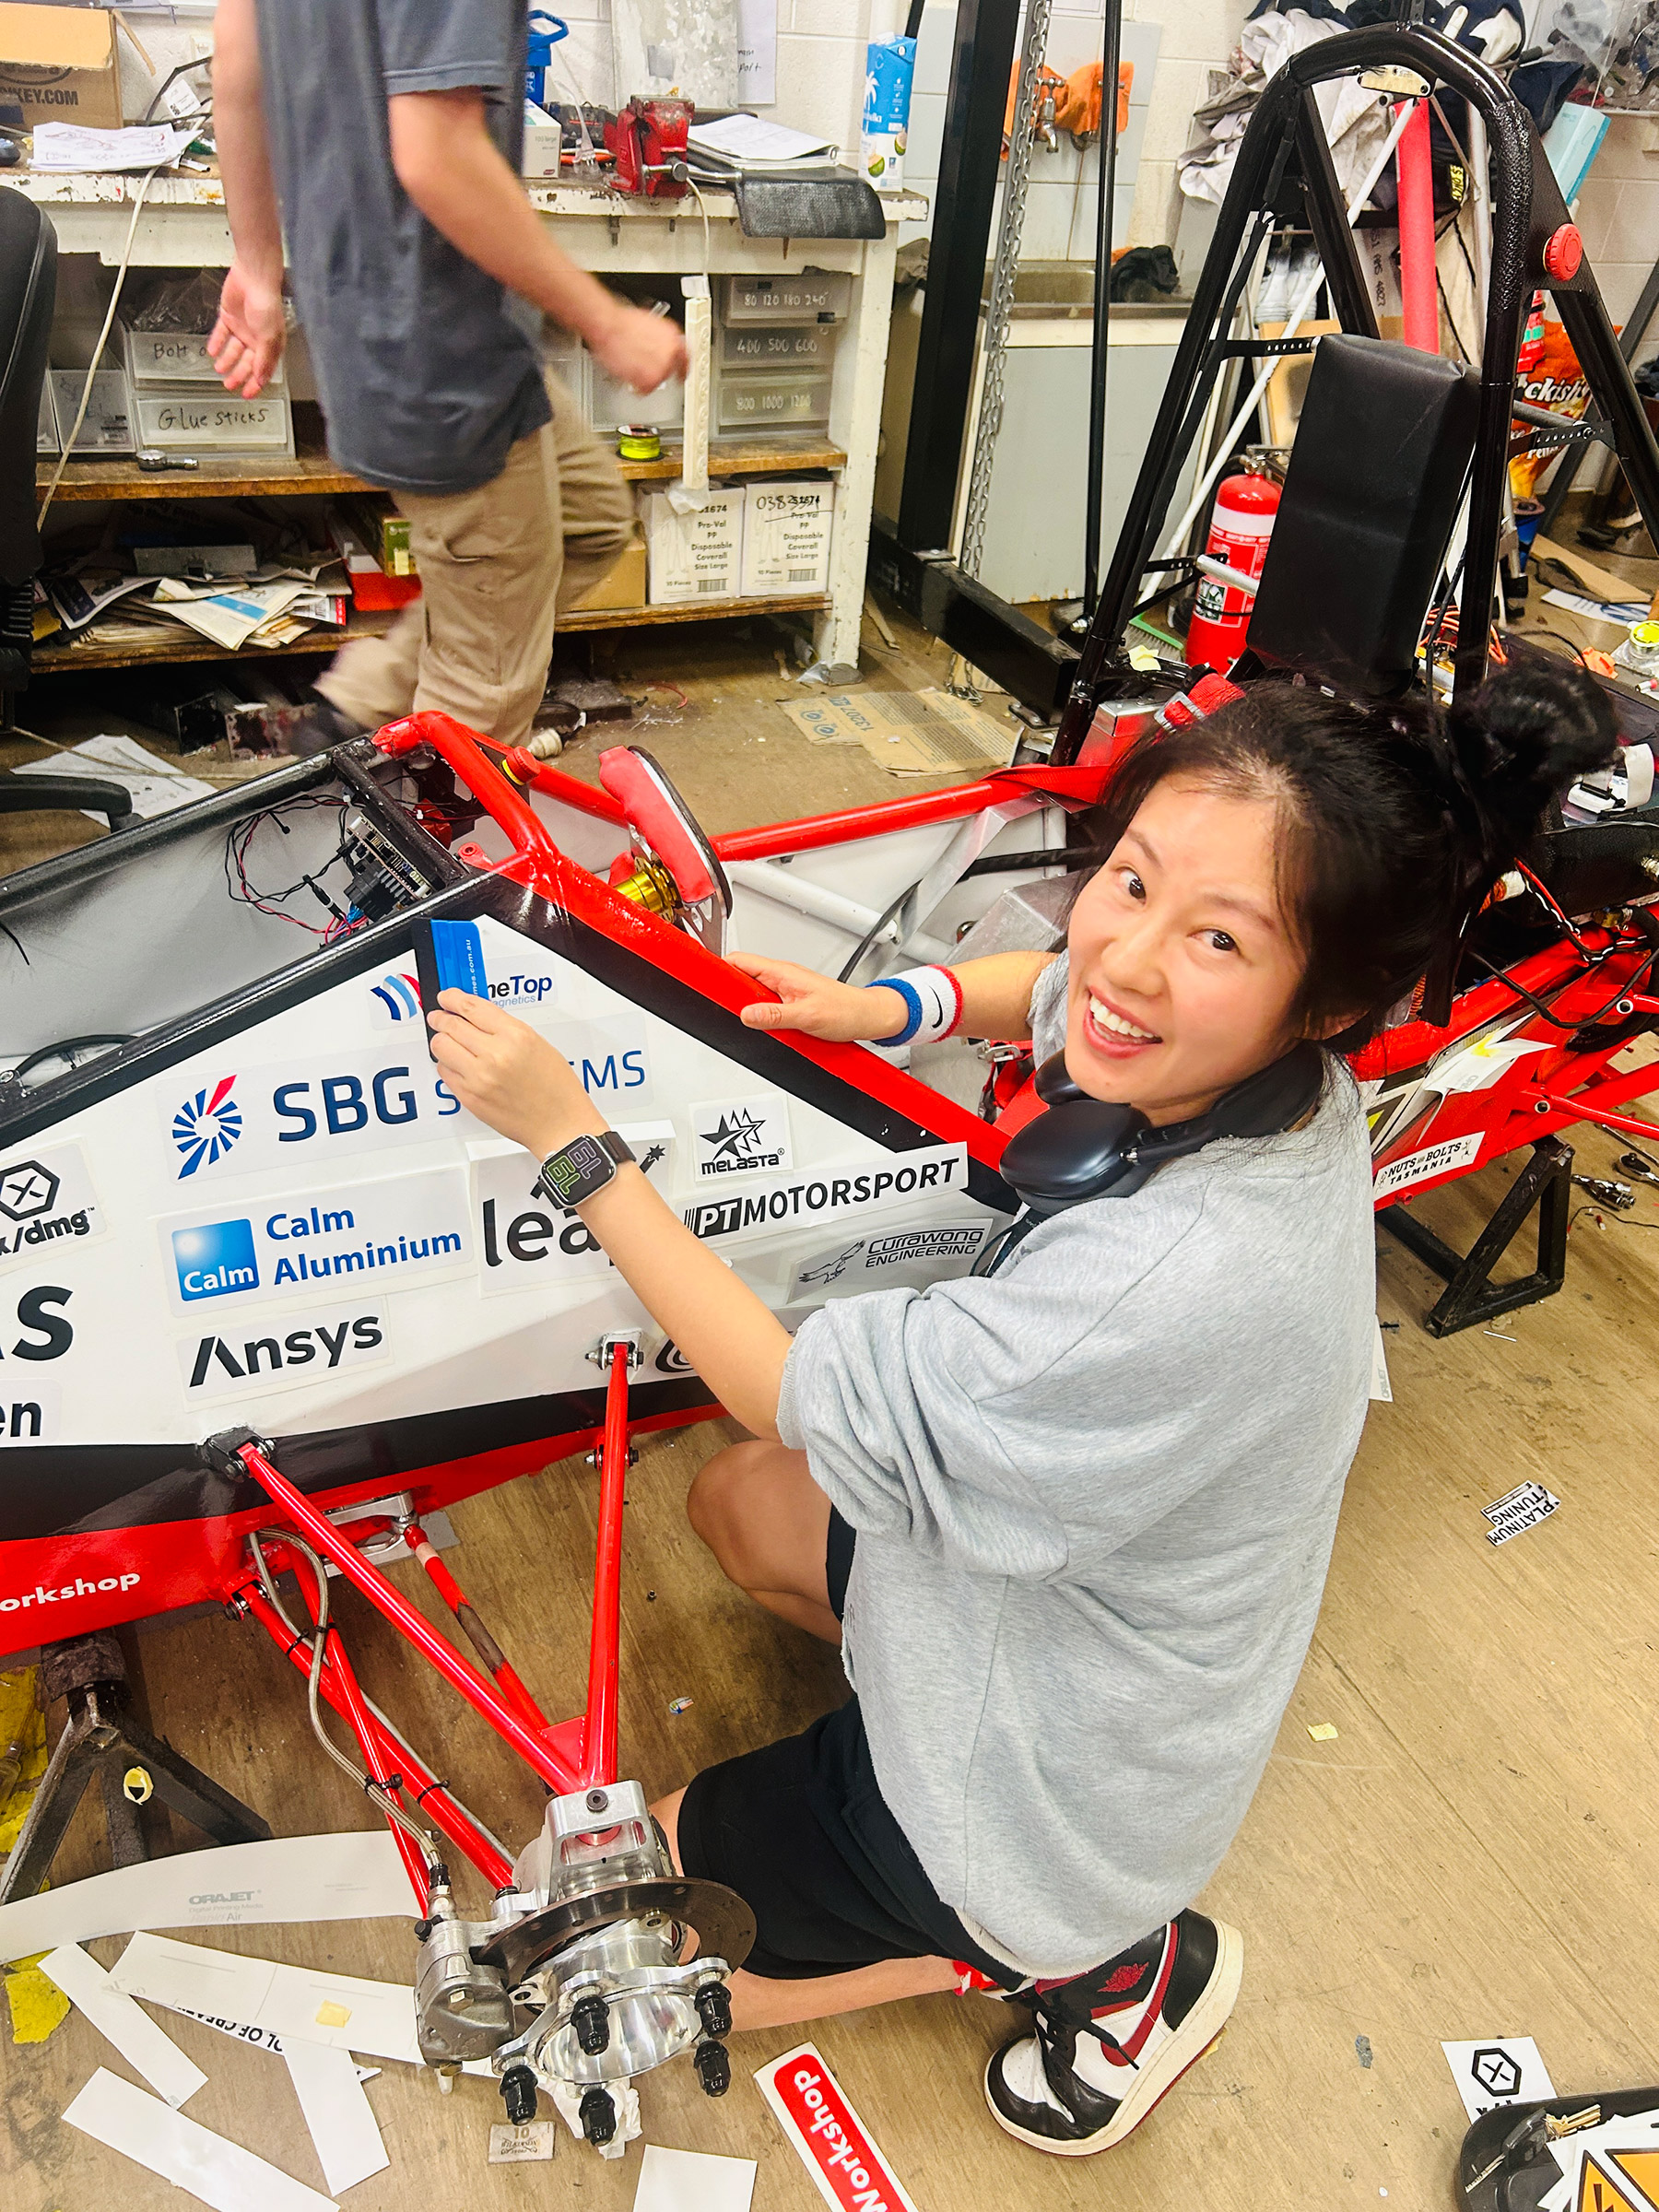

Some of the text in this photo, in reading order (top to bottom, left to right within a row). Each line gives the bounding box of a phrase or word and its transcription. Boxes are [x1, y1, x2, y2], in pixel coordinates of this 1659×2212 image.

[3, 88, 79, 105] KEY.COM
[763, 294, 780, 306] 120
[737, 338, 818, 353] 400 500 600
[762, 395, 782, 409] 1000
[158, 407, 269, 430] Glue sticks
[691, 542, 732, 551] Disposable
[783, 532, 823, 541] Disposable
[697, 552, 727, 560] Coverall
[492, 995, 536, 1009] agnetics
[274, 1066, 418, 1142] SBG
[1387, 1157, 1418, 1177] NUTS
[1425, 1142, 1462, 1162] BOLTS
[1390, 1156, 1452, 1185] TASMANIA
[266, 1206, 356, 1241] Calm
[482, 1198, 616, 1268] lea
[274, 1230, 462, 1286] Aluminium
[865, 1245, 977, 1268] ENGINEERING
[183, 1264, 255, 1294] Calm
[0, 1286, 74, 1361] S
[189, 1315, 383, 1388] Ansys
[1490, 1491, 1545, 1525] TUNING
[1487, 1500, 1555, 1544] PLATINUM
[188, 1890, 255, 1905] ORAJET
[188, 1905, 212, 1913] Digital
[227, 1912, 242, 1922] Air
[514, 2126, 530, 2139] 10
